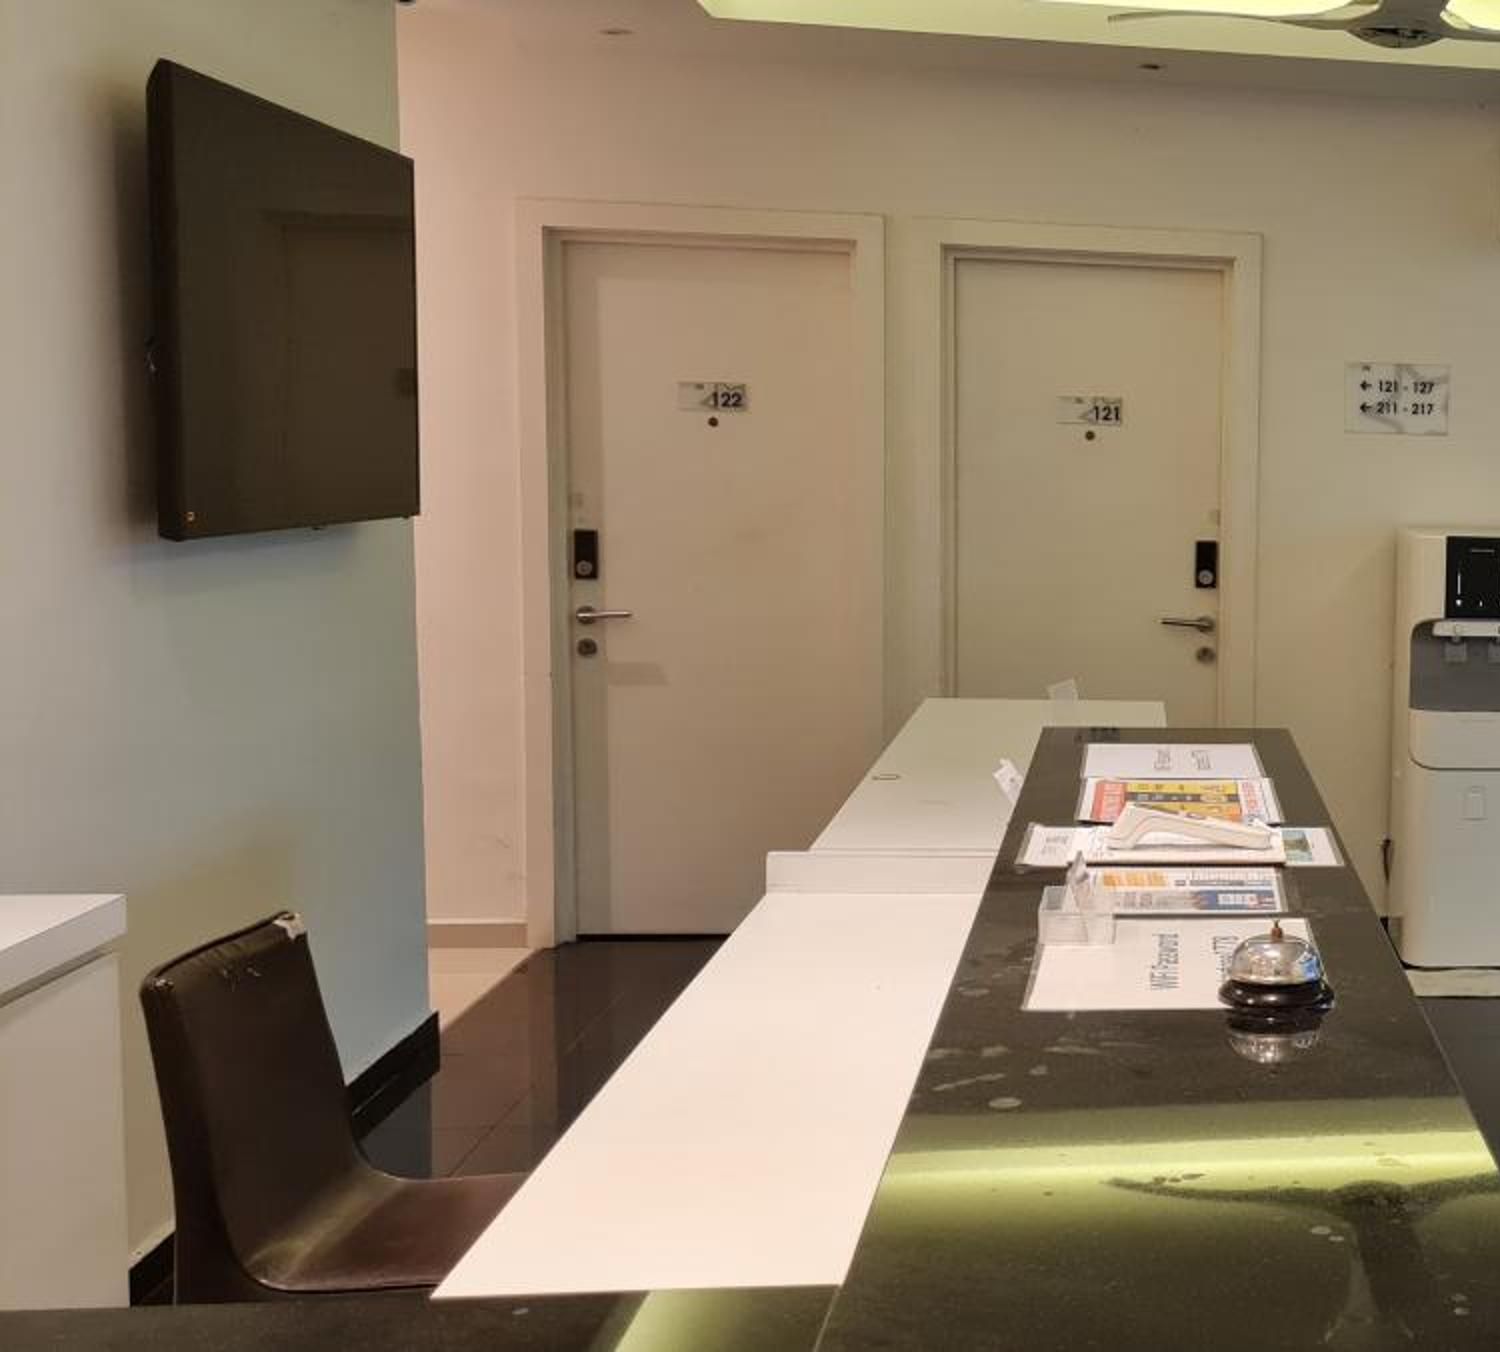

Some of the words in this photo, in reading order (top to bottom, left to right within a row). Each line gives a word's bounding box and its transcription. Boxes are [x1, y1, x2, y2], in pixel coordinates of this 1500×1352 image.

[1379, 380, 1399, 393] 121
[1413, 381, 1435, 394] 127
[712, 391, 743, 408] 122
[1093, 405, 1120, 421] 121
[1376, 401, 1398, 415] 211
[1411, 403, 1434, 415] 217
